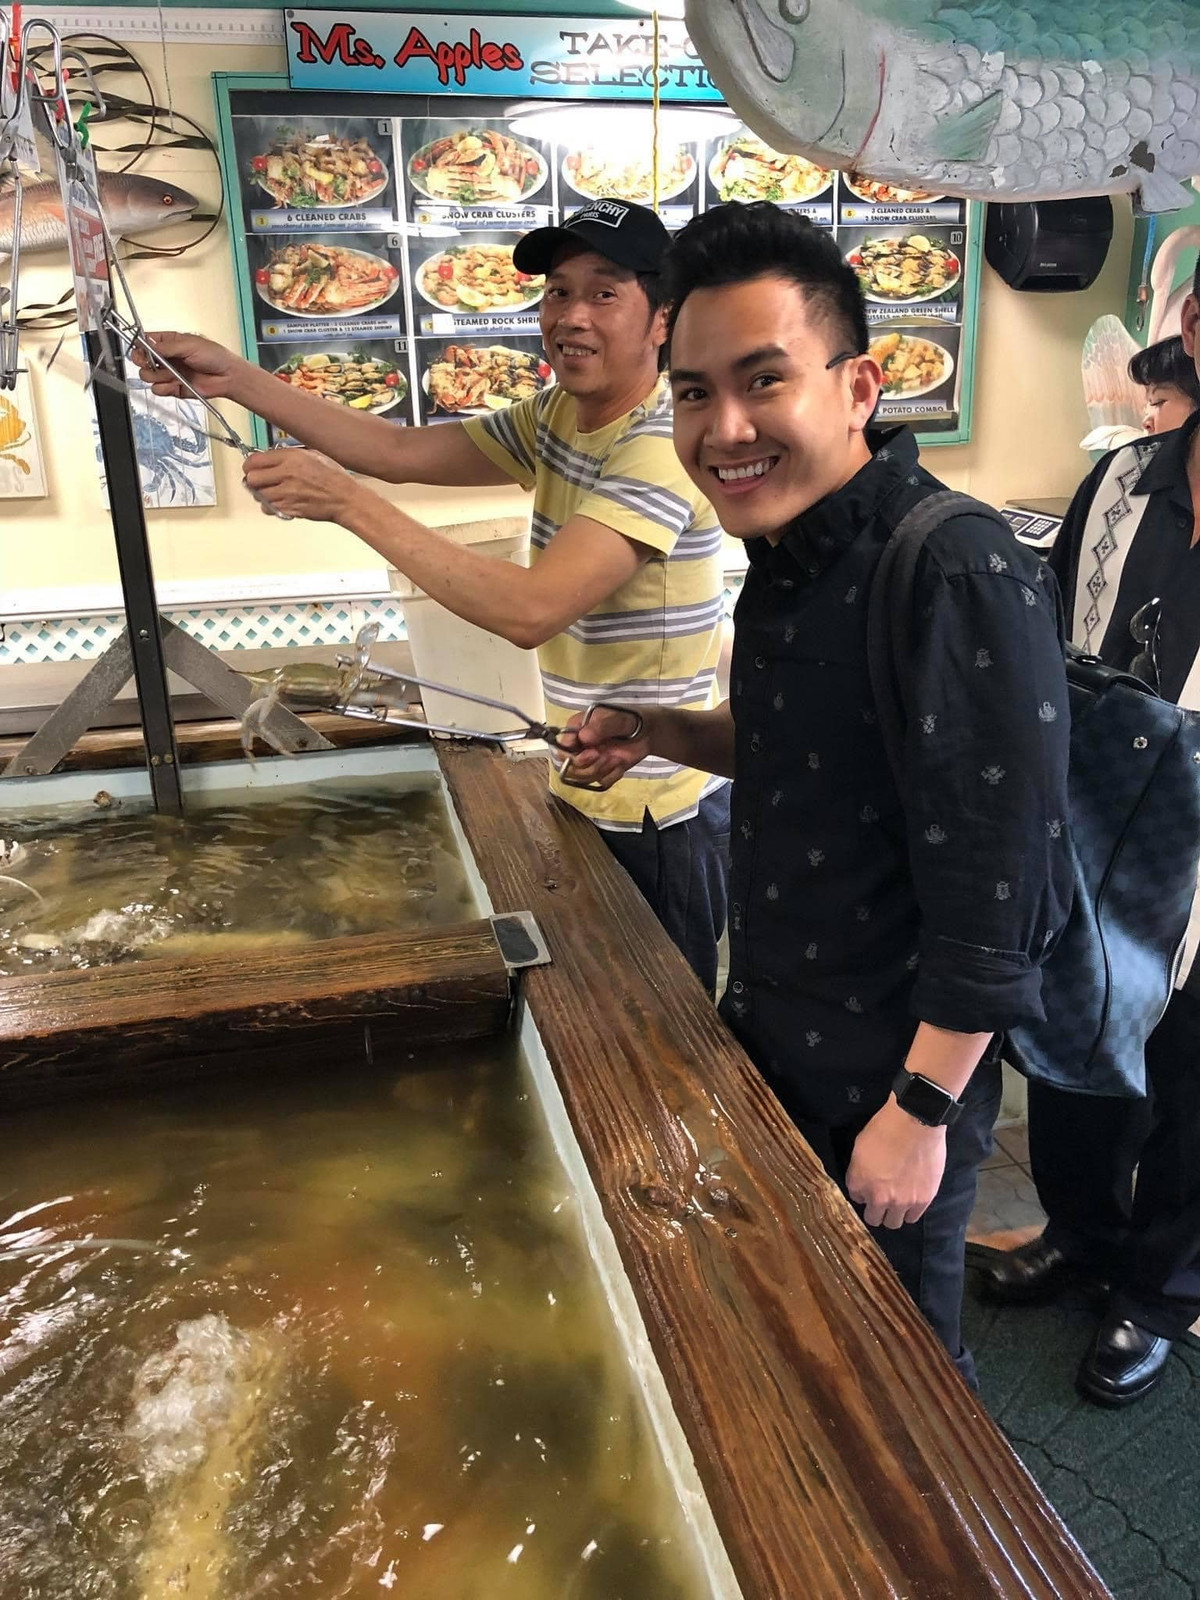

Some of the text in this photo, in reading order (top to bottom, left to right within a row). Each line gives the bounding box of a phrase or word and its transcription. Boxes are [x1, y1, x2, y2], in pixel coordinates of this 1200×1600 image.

[290, 21, 525, 86] Ms. Apples
[530, 60, 720, 90] SELECTI
[381, 122, 389, 133] 1
[286, 212, 367, 222] 6 CLEANED CRABS
[471, 211, 494, 219] CRAB
[391, 237, 399, 246] 6
[491, 317, 515, 325] ROCK
[396, 341, 407, 351] 11
[882, 406, 913, 414] POTATO
